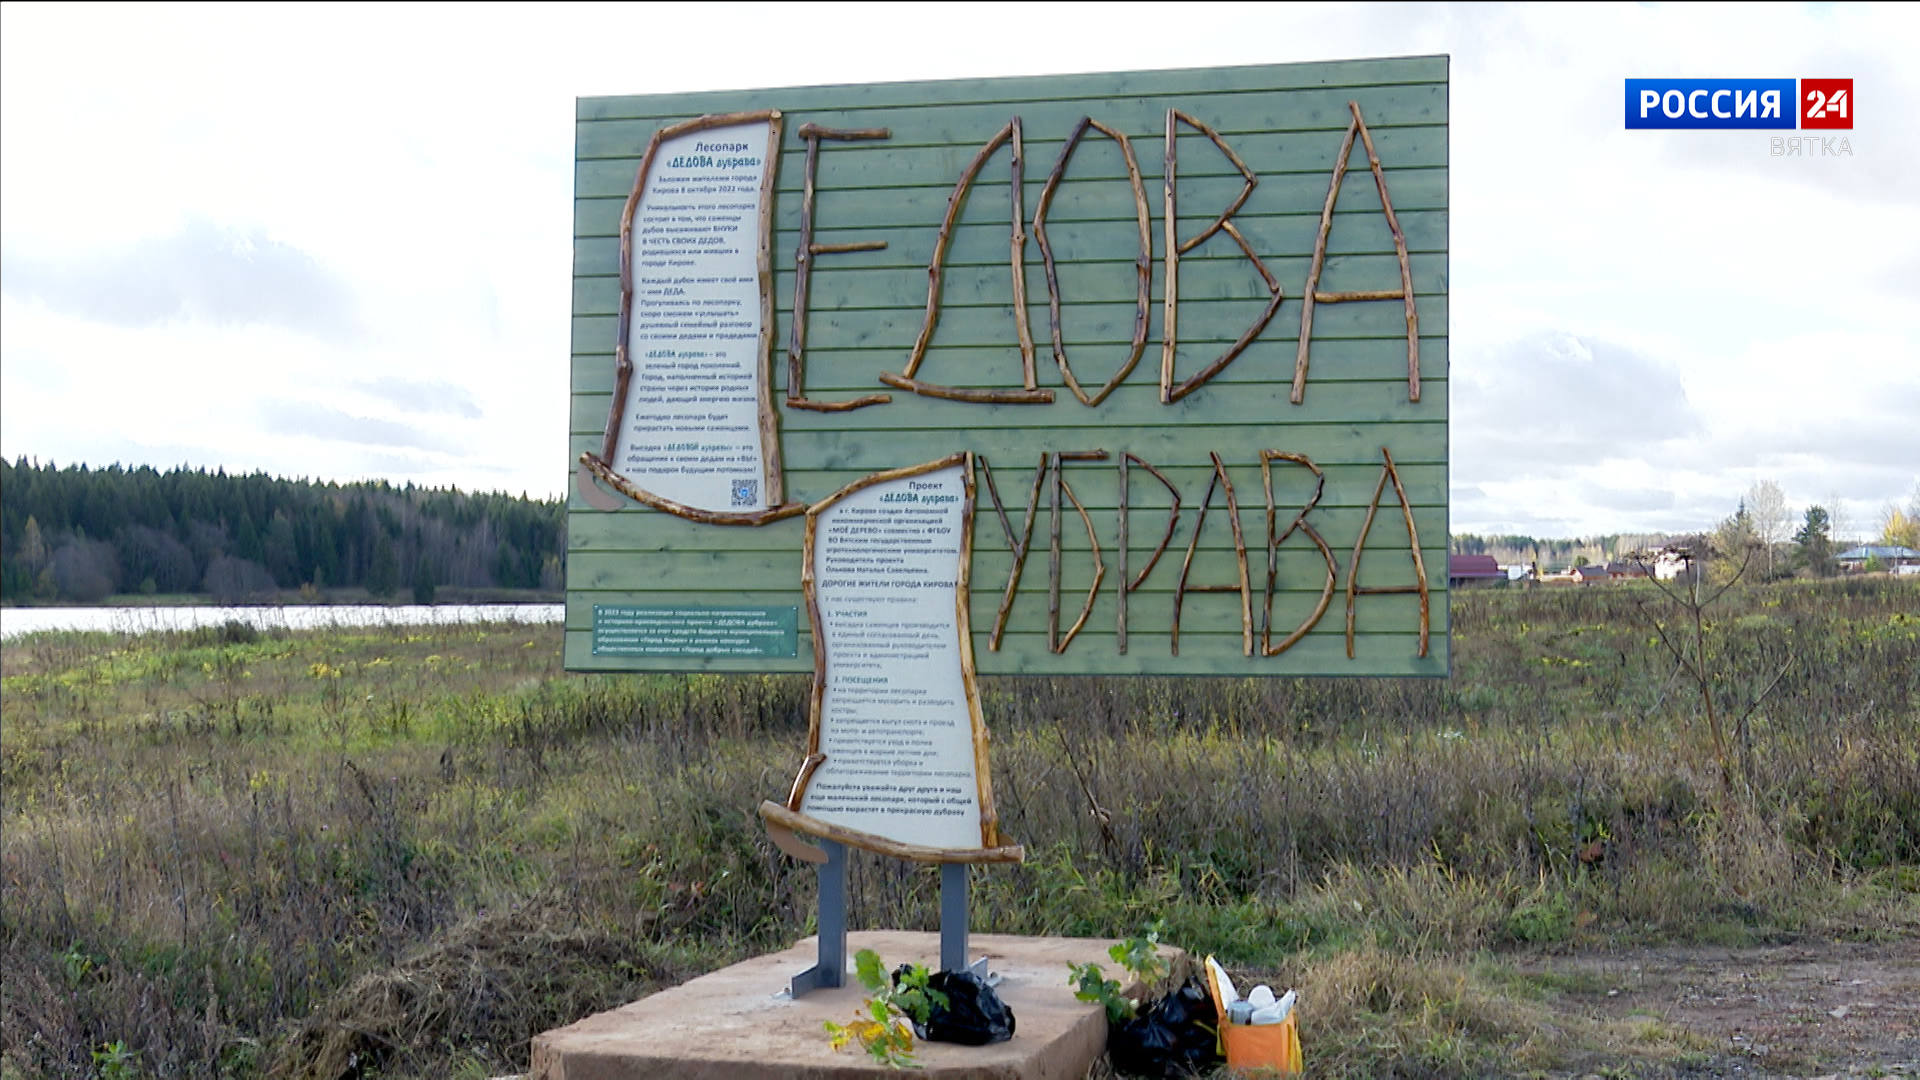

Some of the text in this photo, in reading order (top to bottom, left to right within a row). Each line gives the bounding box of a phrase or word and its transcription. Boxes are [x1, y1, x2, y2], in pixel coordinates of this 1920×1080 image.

[694, 142, 749, 153] Лесопарк
[666, 156, 761, 169] «ДЕДОВА дубрава»
[908, 481, 943, 490] Проект
[878, 493, 960, 504] «ДЕДОВА дубрава»
